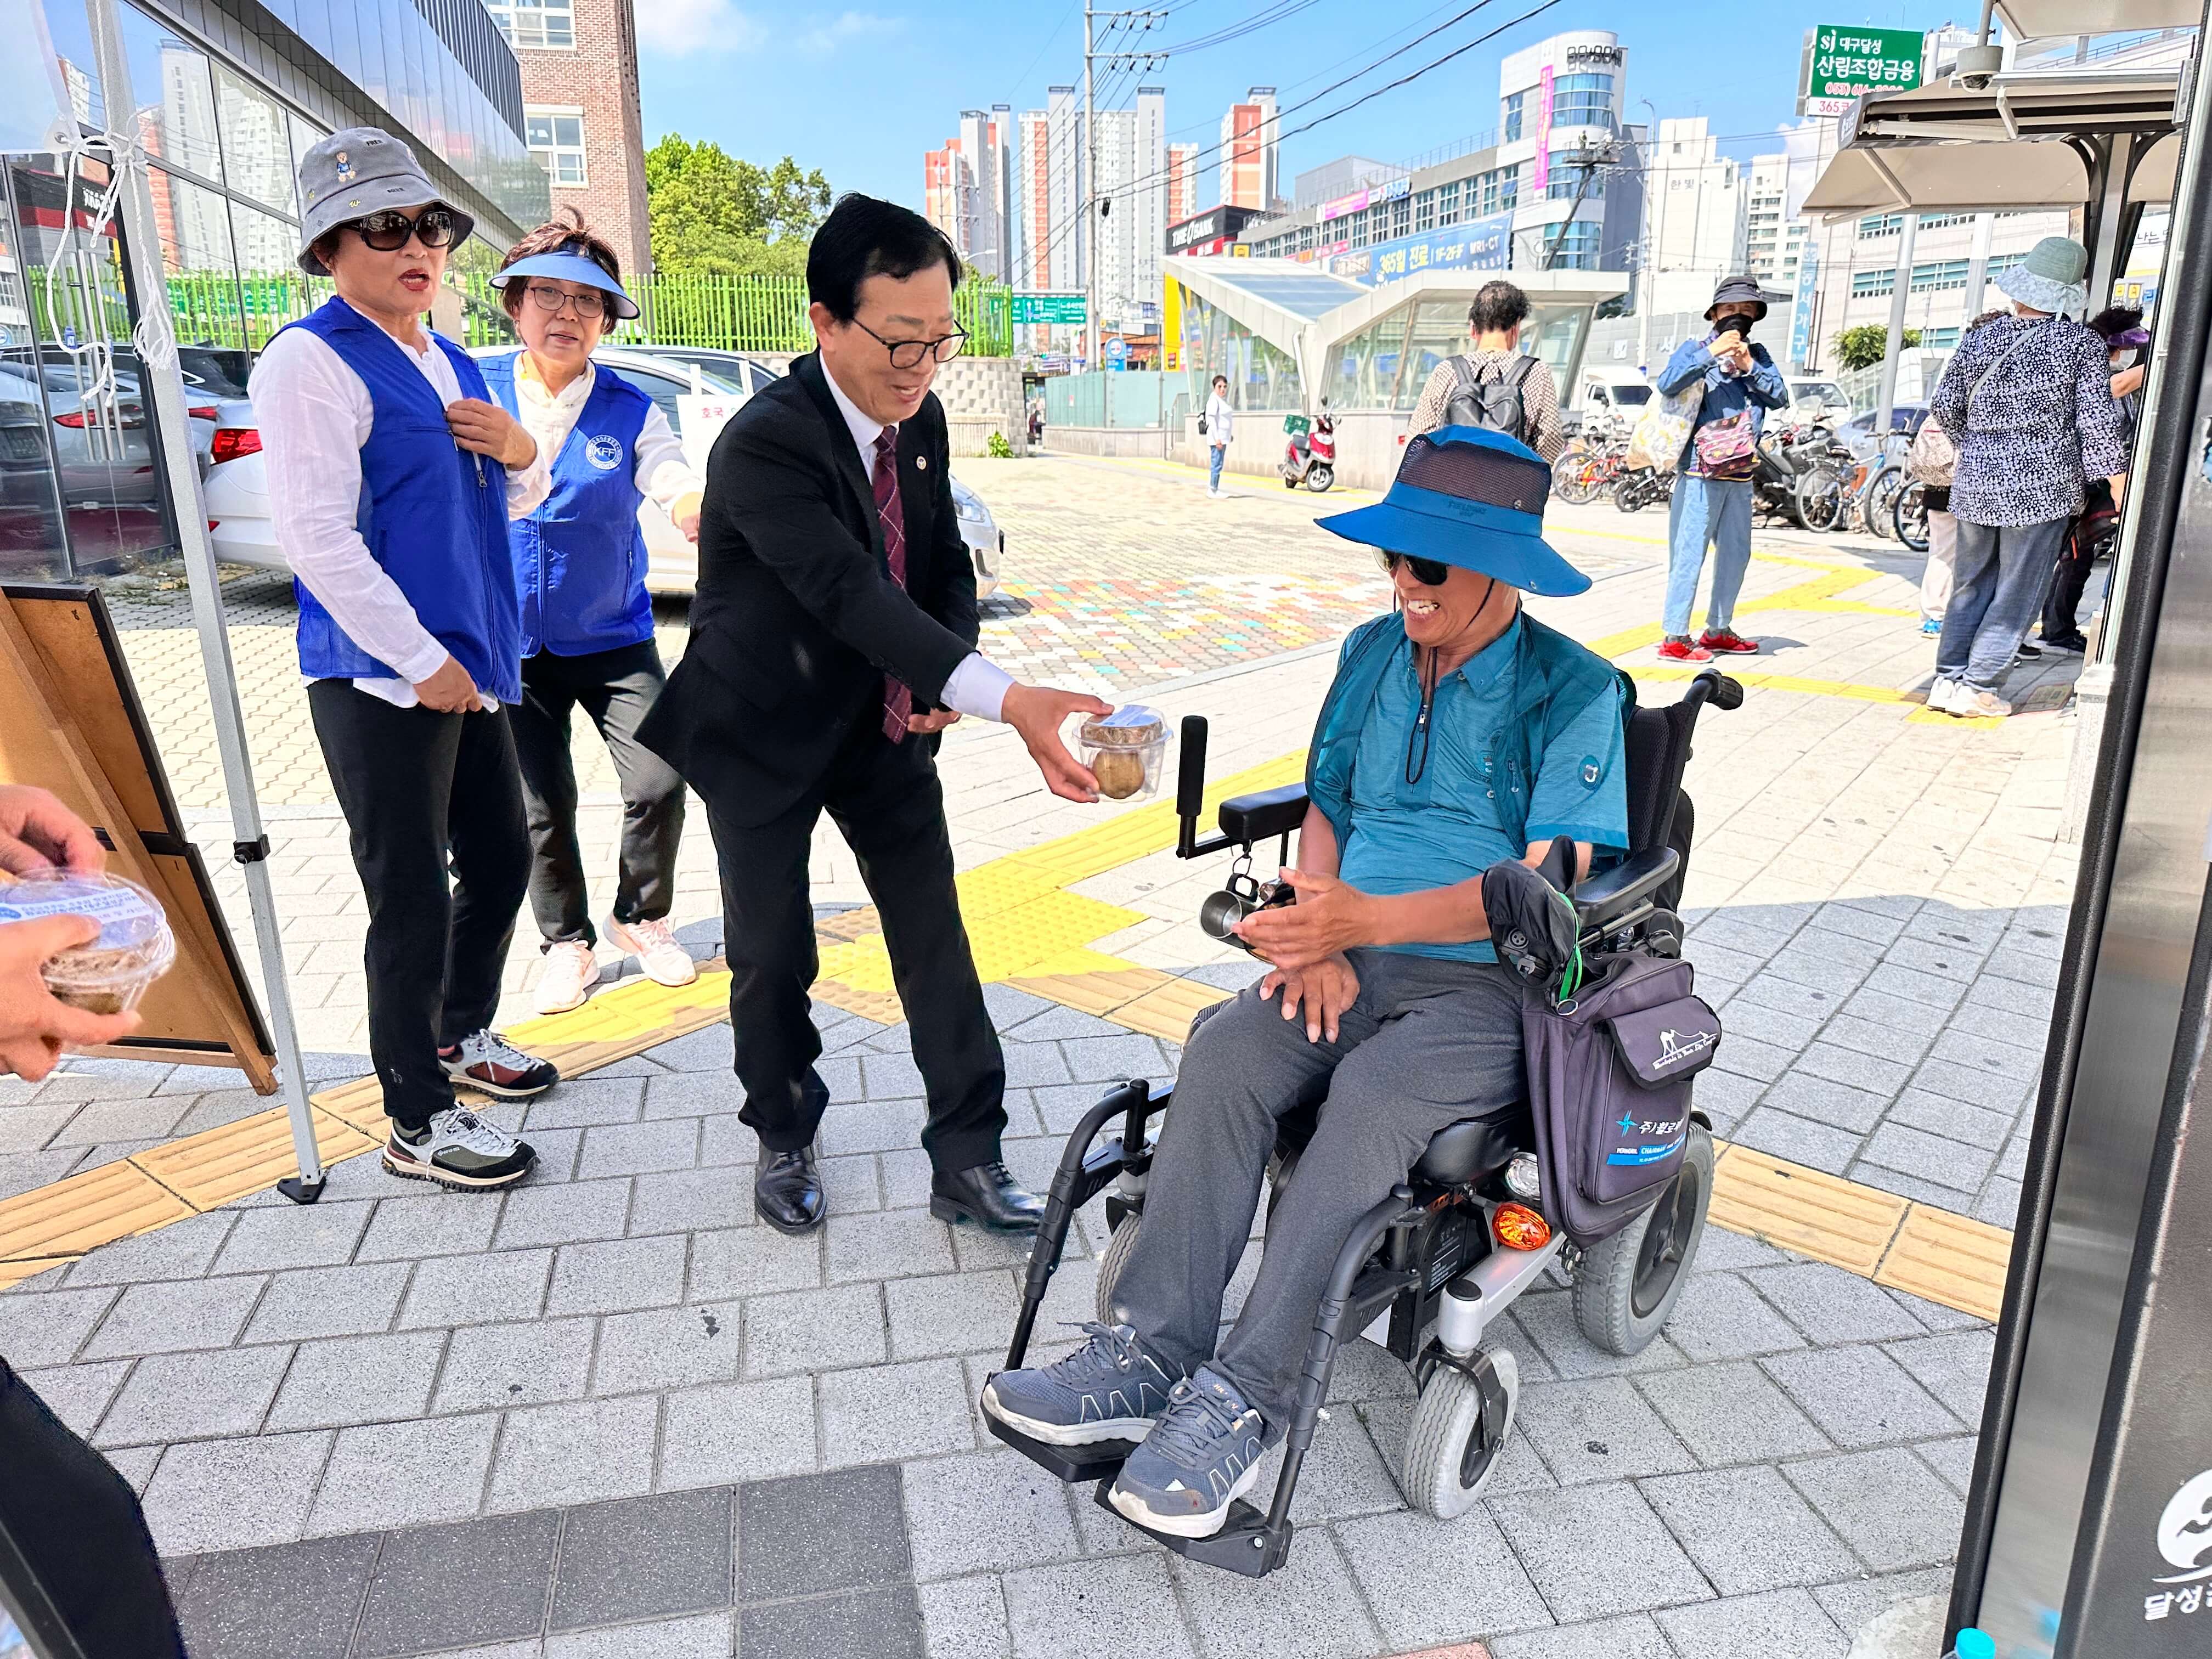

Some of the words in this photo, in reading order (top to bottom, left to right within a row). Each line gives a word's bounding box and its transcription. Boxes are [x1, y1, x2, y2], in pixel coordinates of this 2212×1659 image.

[1839, 37, 1882, 54] 대구달성
[1816, 55, 1915, 81] 산림조합금융
[1671, 178, 1695, 190] 한빛
[1409, 244, 1429, 269] 진료
[594, 447, 615, 456] KFF
[2144, 1583, 2212, 1621] 달성
